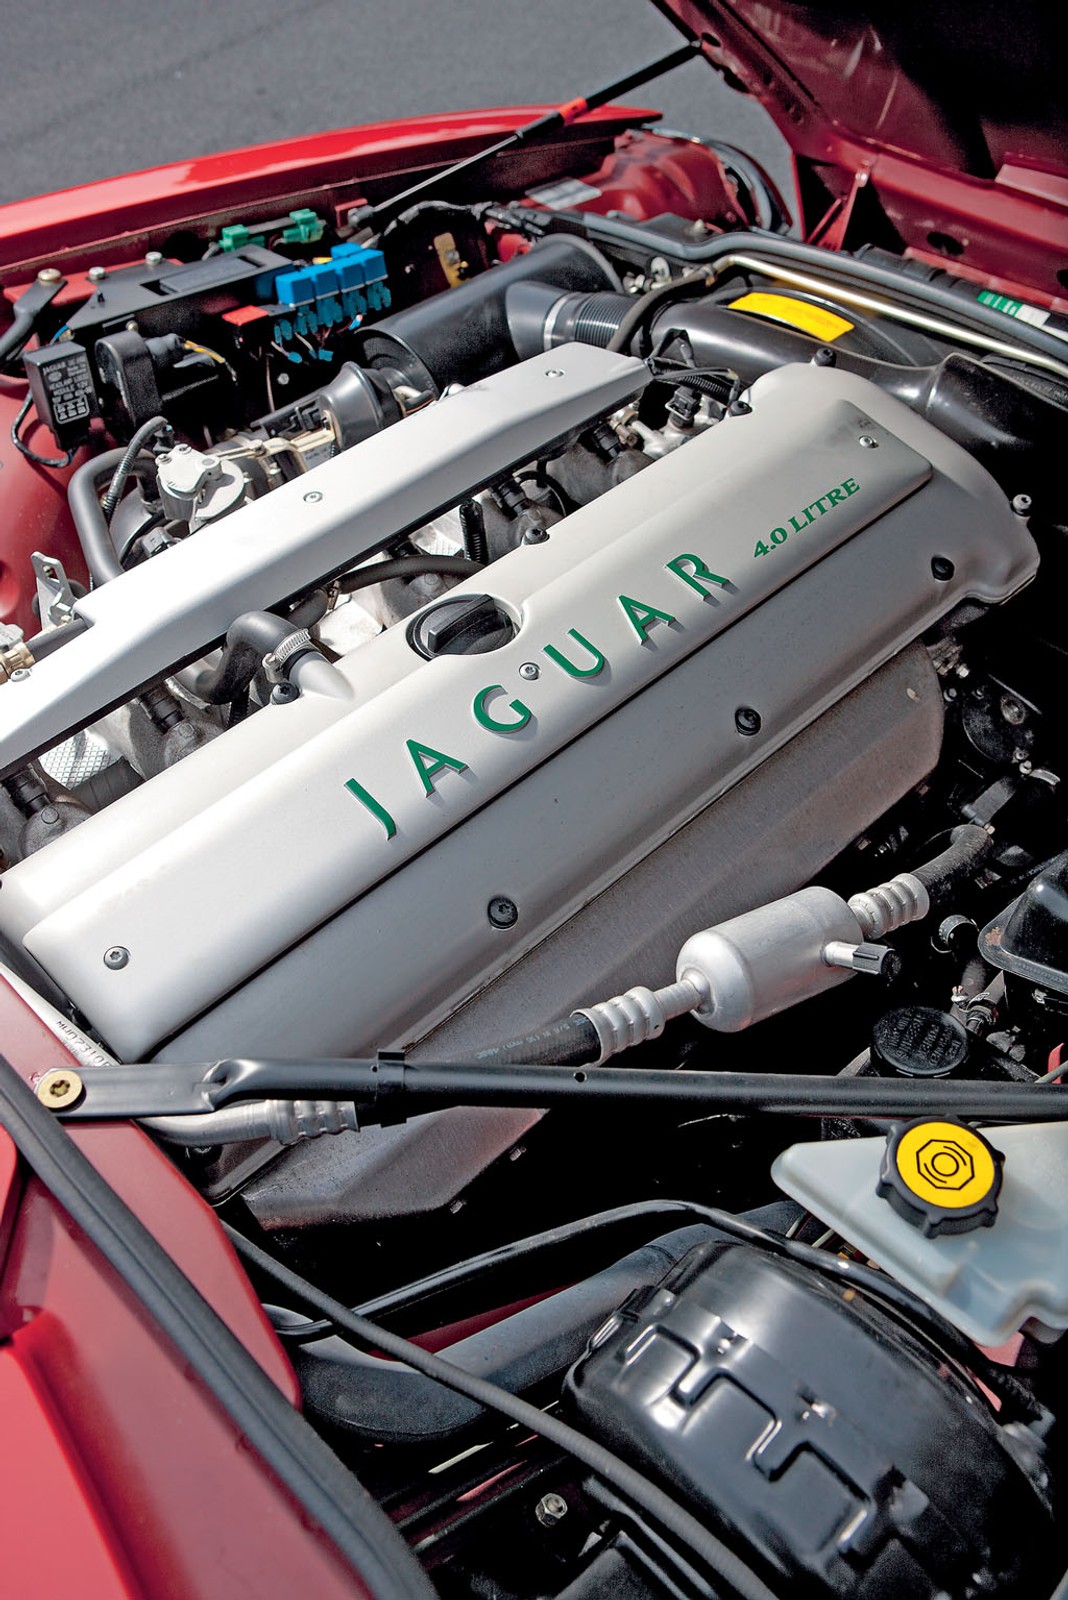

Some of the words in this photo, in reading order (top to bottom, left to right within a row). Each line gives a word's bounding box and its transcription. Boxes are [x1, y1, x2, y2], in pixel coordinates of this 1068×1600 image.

[753, 527, 788, 558] 4.0
[788, 477, 861, 534] LITRE
[344, 553, 731, 841] JAGUAR
